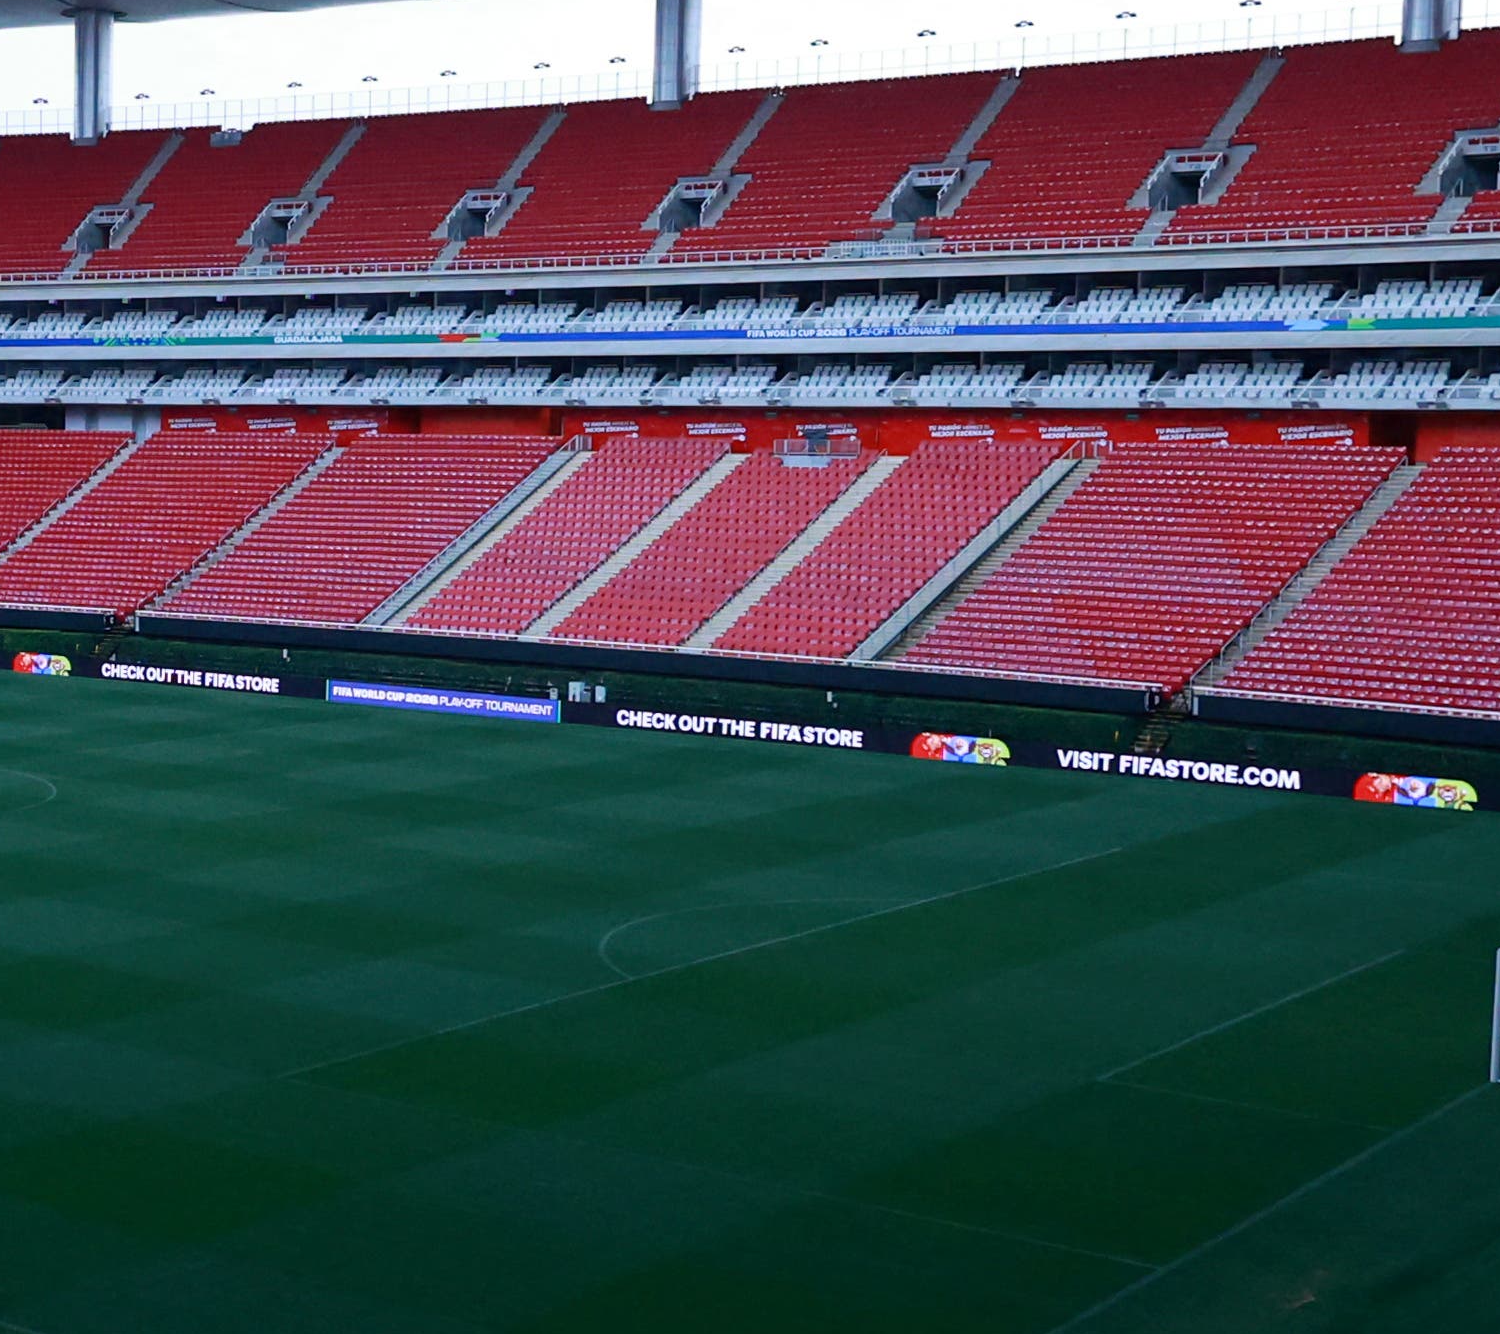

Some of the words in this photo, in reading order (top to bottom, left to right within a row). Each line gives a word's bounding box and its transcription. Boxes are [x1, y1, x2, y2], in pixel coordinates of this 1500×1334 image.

[274, 335, 343, 344] GUADALAJARA
[747, 330, 766, 338] FIFA
[767, 329, 797, 338] WORLD
[799, 329, 816, 337] CUP
[893, 326, 955, 336] TOURNAMENT
[102, 663, 145, 680] CHECK
[146, 667, 174, 682] OUT
[175, 670, 202, 685] THE
[205, 673, 235, 688] FIFA
[236, 675, 279, 692] STORE
[332, 686, 352, 697] FIFA
[353, 687, 386, 700] WORLD
[386, 690, 405, 702] CUP
[405, 692, 438, 705] 2026
[440, 696, 483, 710] PLAY-OFF
[485, 699, 553, 716] TOURNAMENT
[617, 710, 676, 730] CHECK
[679, 715, 717, 733] OUT
[719, 719, 755, 737] THE
[760, 722, 801, 741] FIFA
[803, 726, 863, 747] STORE
[1058, 750, 1114, 771] VISIT
[1120, 755, 1300, 789] FIFASTORE.COM
